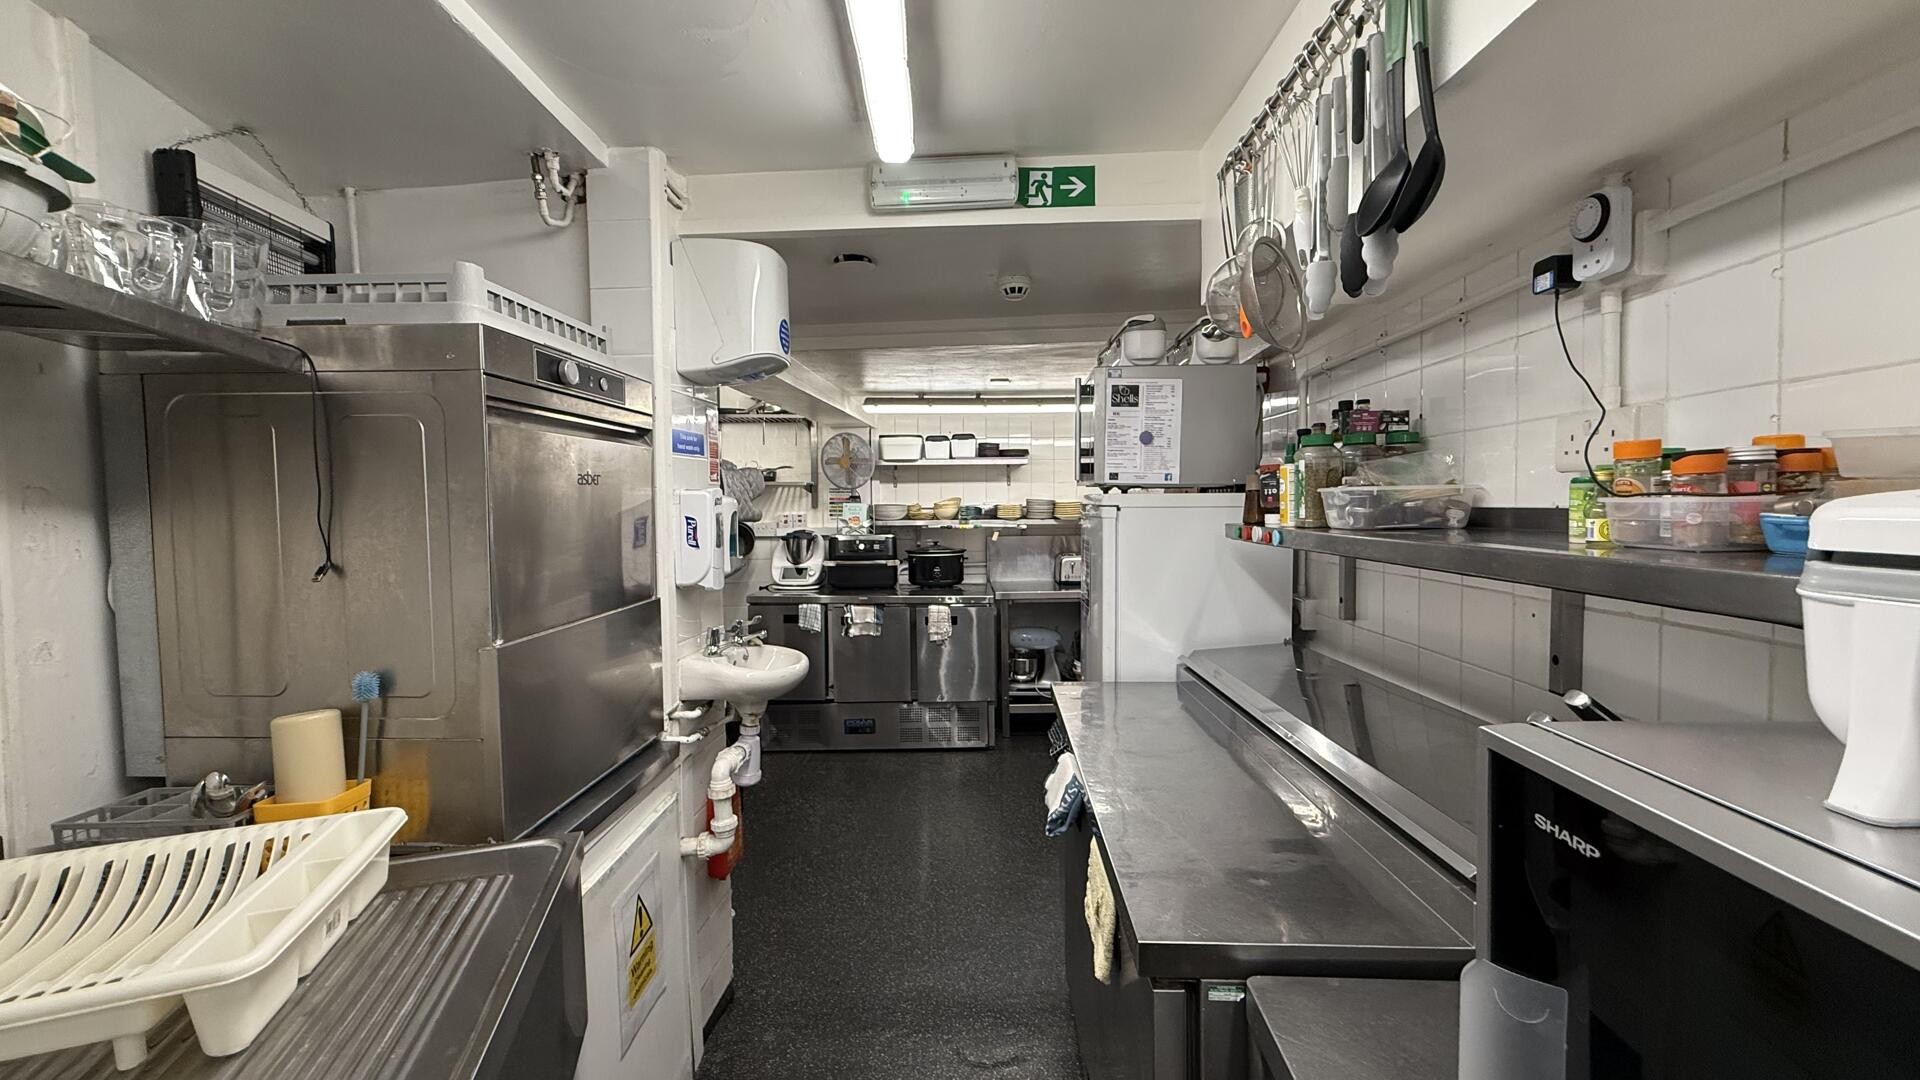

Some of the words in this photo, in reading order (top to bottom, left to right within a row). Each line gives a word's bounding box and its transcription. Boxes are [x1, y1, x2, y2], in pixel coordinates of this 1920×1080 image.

[1111, 393, 1139, 404] Shells
[577, 471, 601, 486] asber
[687, 519, 697, 546] Purell
[1534, 812, 1601, 858] SHARP
